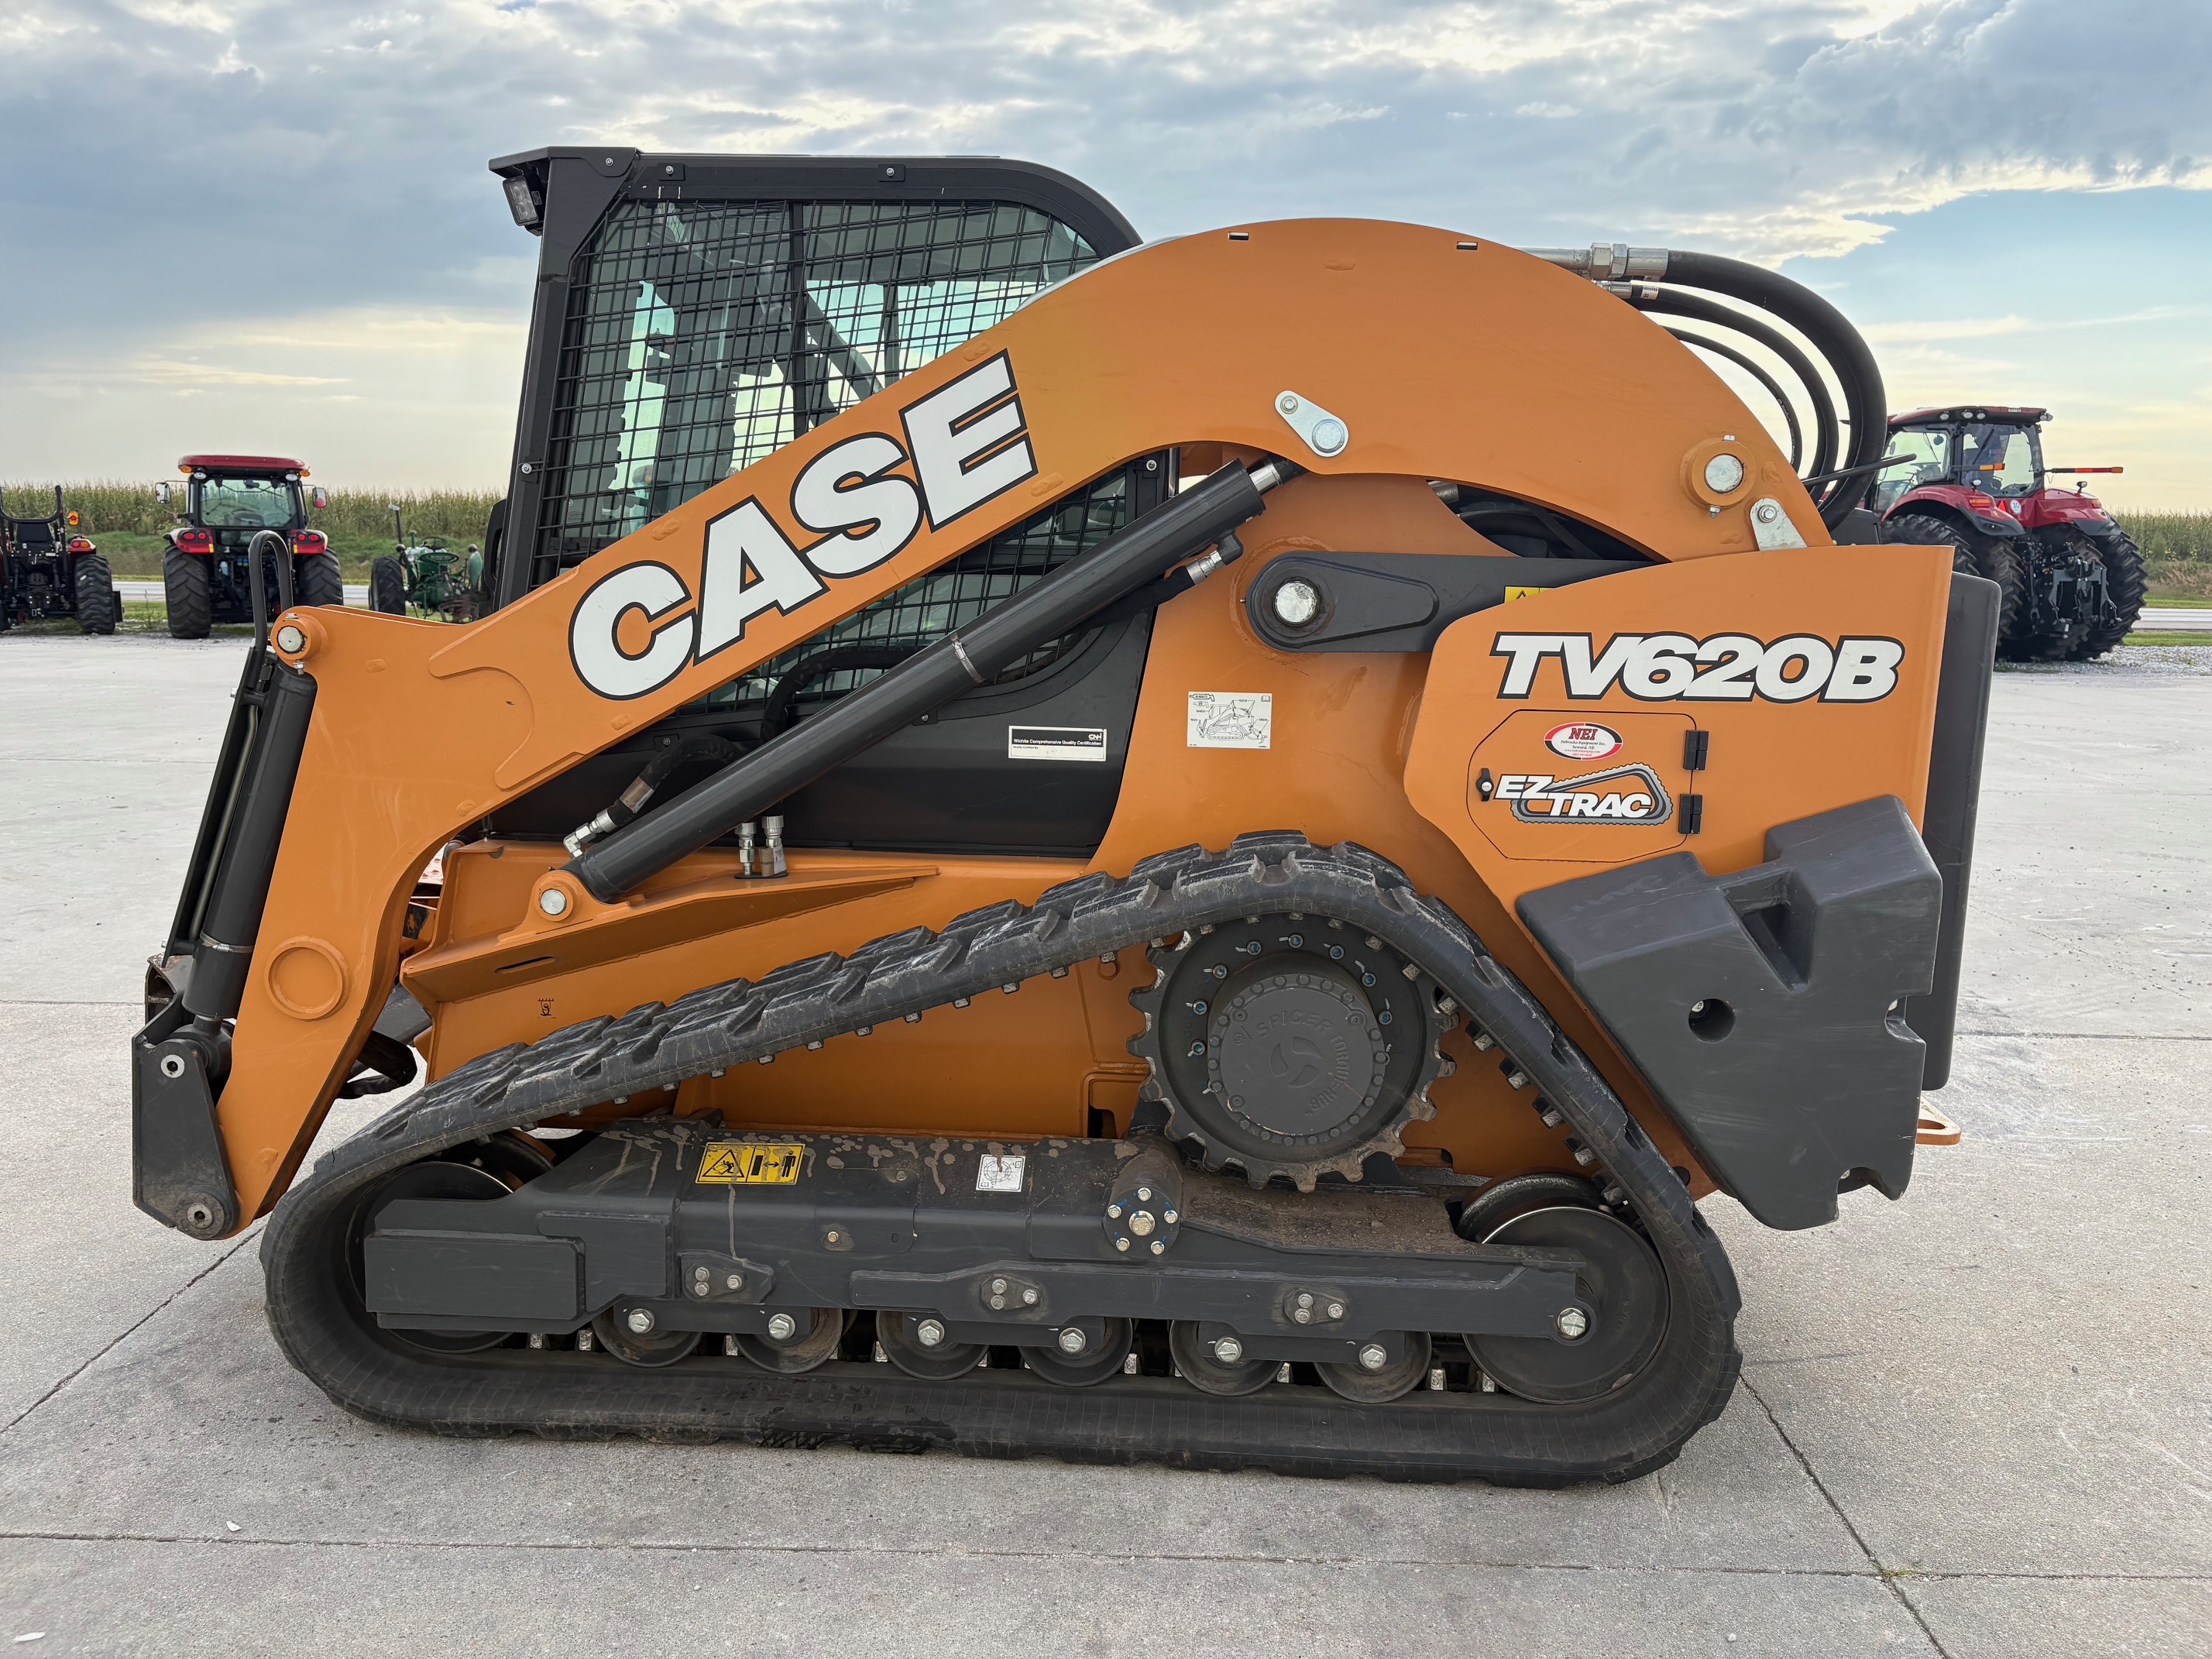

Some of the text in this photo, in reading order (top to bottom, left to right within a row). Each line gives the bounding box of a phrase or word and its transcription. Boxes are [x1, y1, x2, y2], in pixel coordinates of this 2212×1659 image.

[568, 349, 1039, 700] CASE
[1490, 631, 1905, 703] TV620B
[1568, 727, 1598, 740] NEI
[1493, 774, 1555, 799] EZ
[1547, 792, 1652, 818] TRAC
[1256, 1009, 1333, 1038] SPICER
